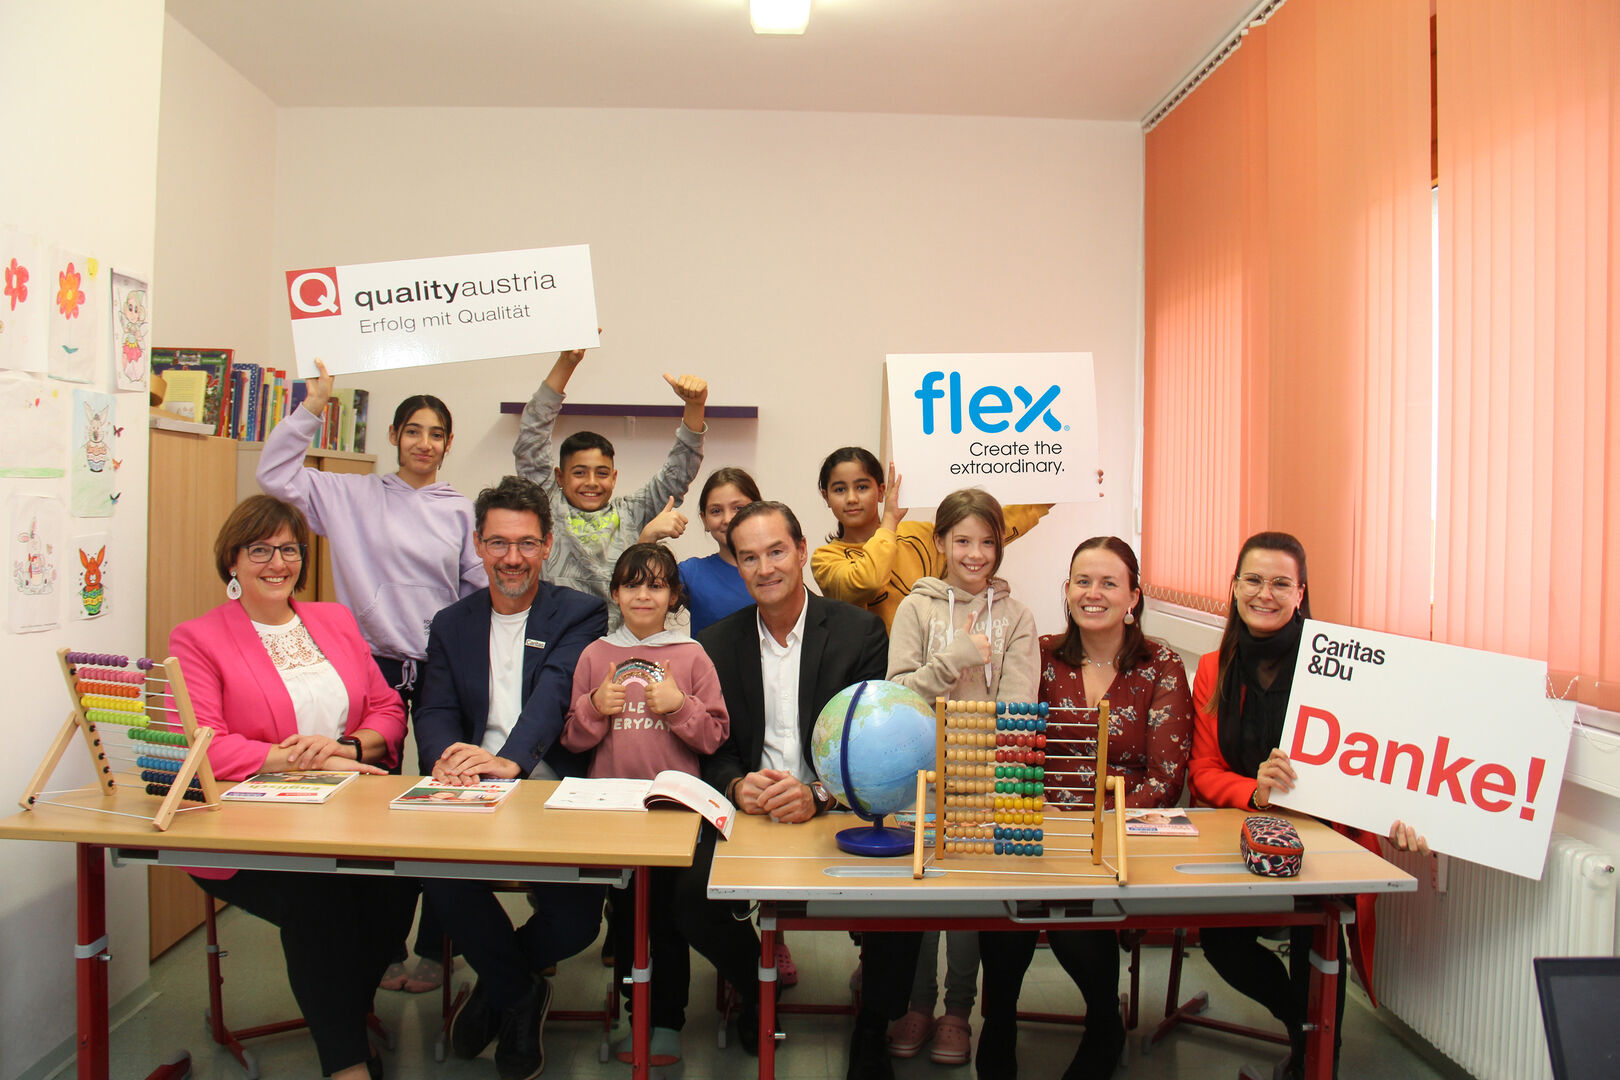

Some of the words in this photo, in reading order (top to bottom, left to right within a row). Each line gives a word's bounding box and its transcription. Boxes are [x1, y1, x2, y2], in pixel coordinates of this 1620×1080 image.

[290, 272, 340, 314] Q
[354, 270, 557, 311] qualityaustria
[359, 315, 416, 334] Erfolg
[422, 312, 452, 328] mit
[457, 303, 531, 325] Qualität
[914, 371, 1063, 436] flex
[969, 441, 1029, 457] Create
[1034, 440, 1063, 456] the
[950, 458, 1065, 476] extraordinary.
[1311, 633, 1386, 665] Caritas
[1307, 654, 1353, 681] &Du
[622, 701, 646, 714] ILE
[1289, 704, 1547, 822] Danke!
